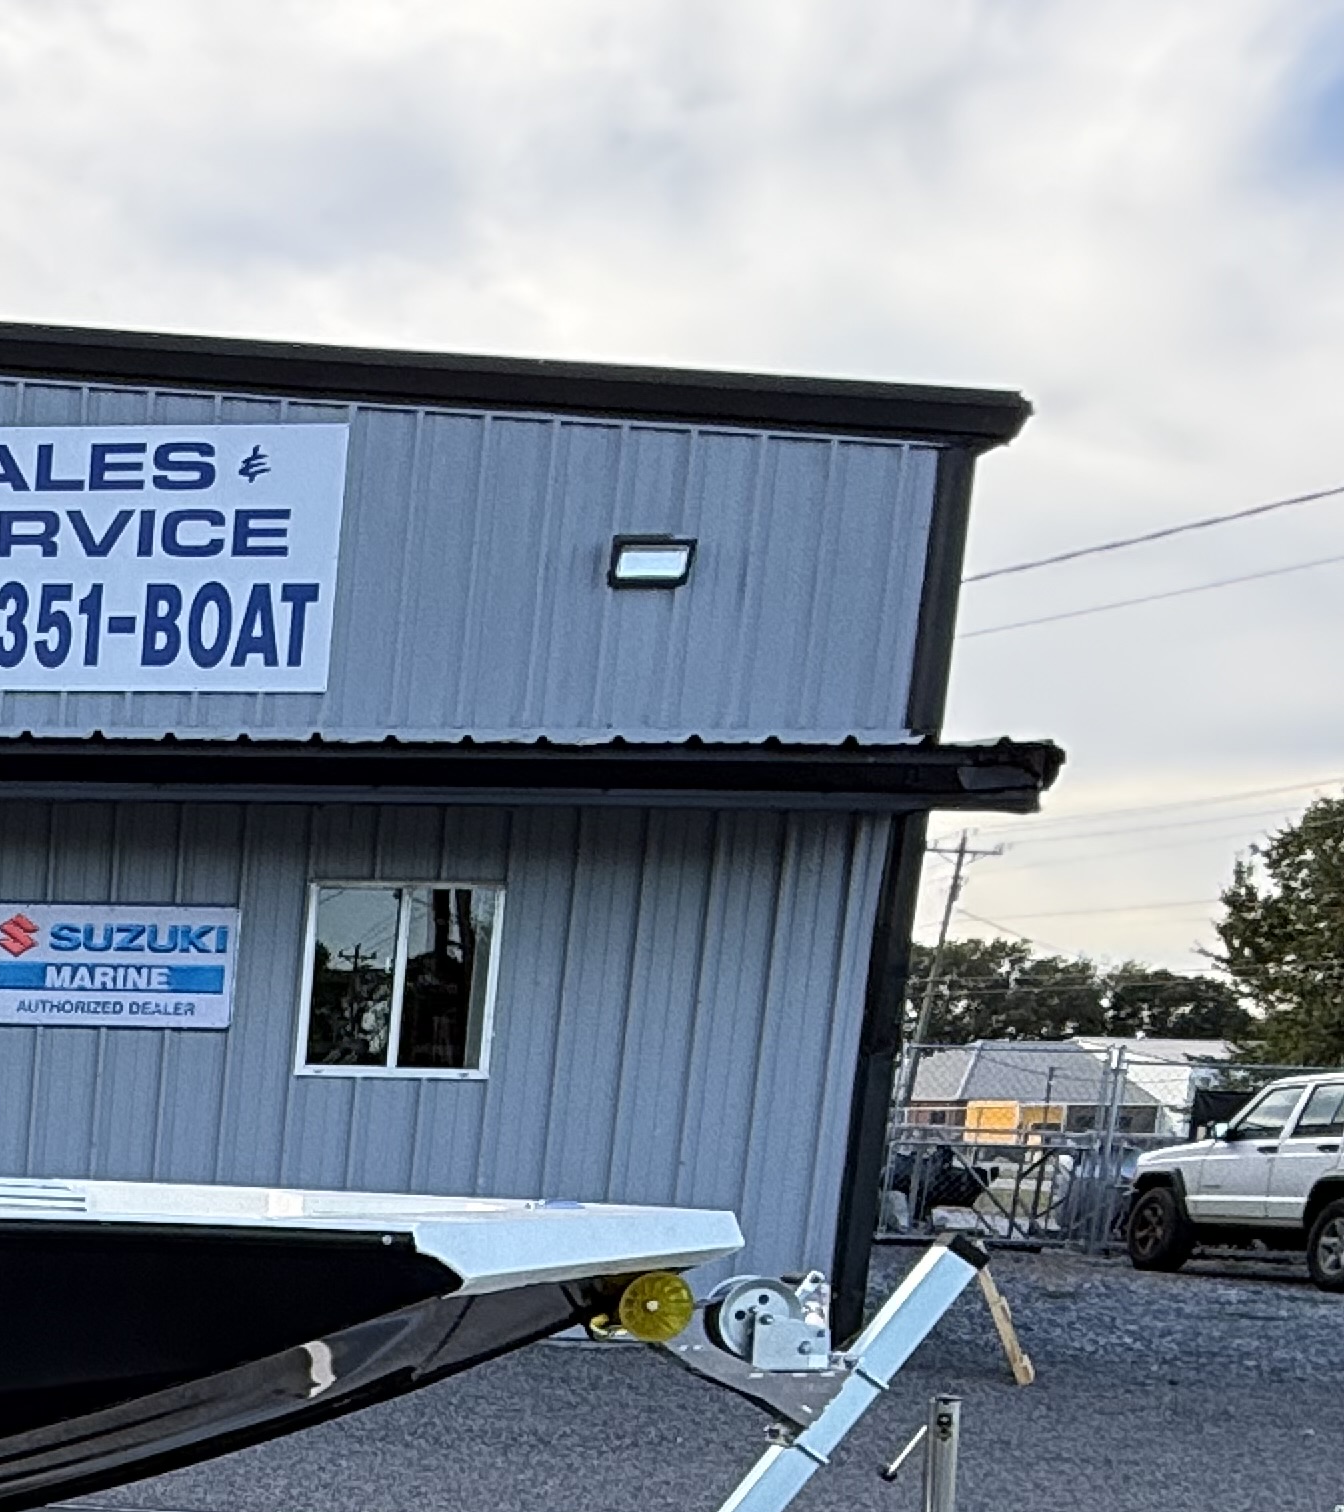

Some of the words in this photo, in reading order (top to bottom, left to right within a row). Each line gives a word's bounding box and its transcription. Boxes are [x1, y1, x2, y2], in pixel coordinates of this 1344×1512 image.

[49, 923, 229, 953] SUZUKI
[44, 965, 171, 990] MARINE
[16, 1000, 123, 1015] AUTHORIZED
[128, 1001, 196, 1016] DEALER
